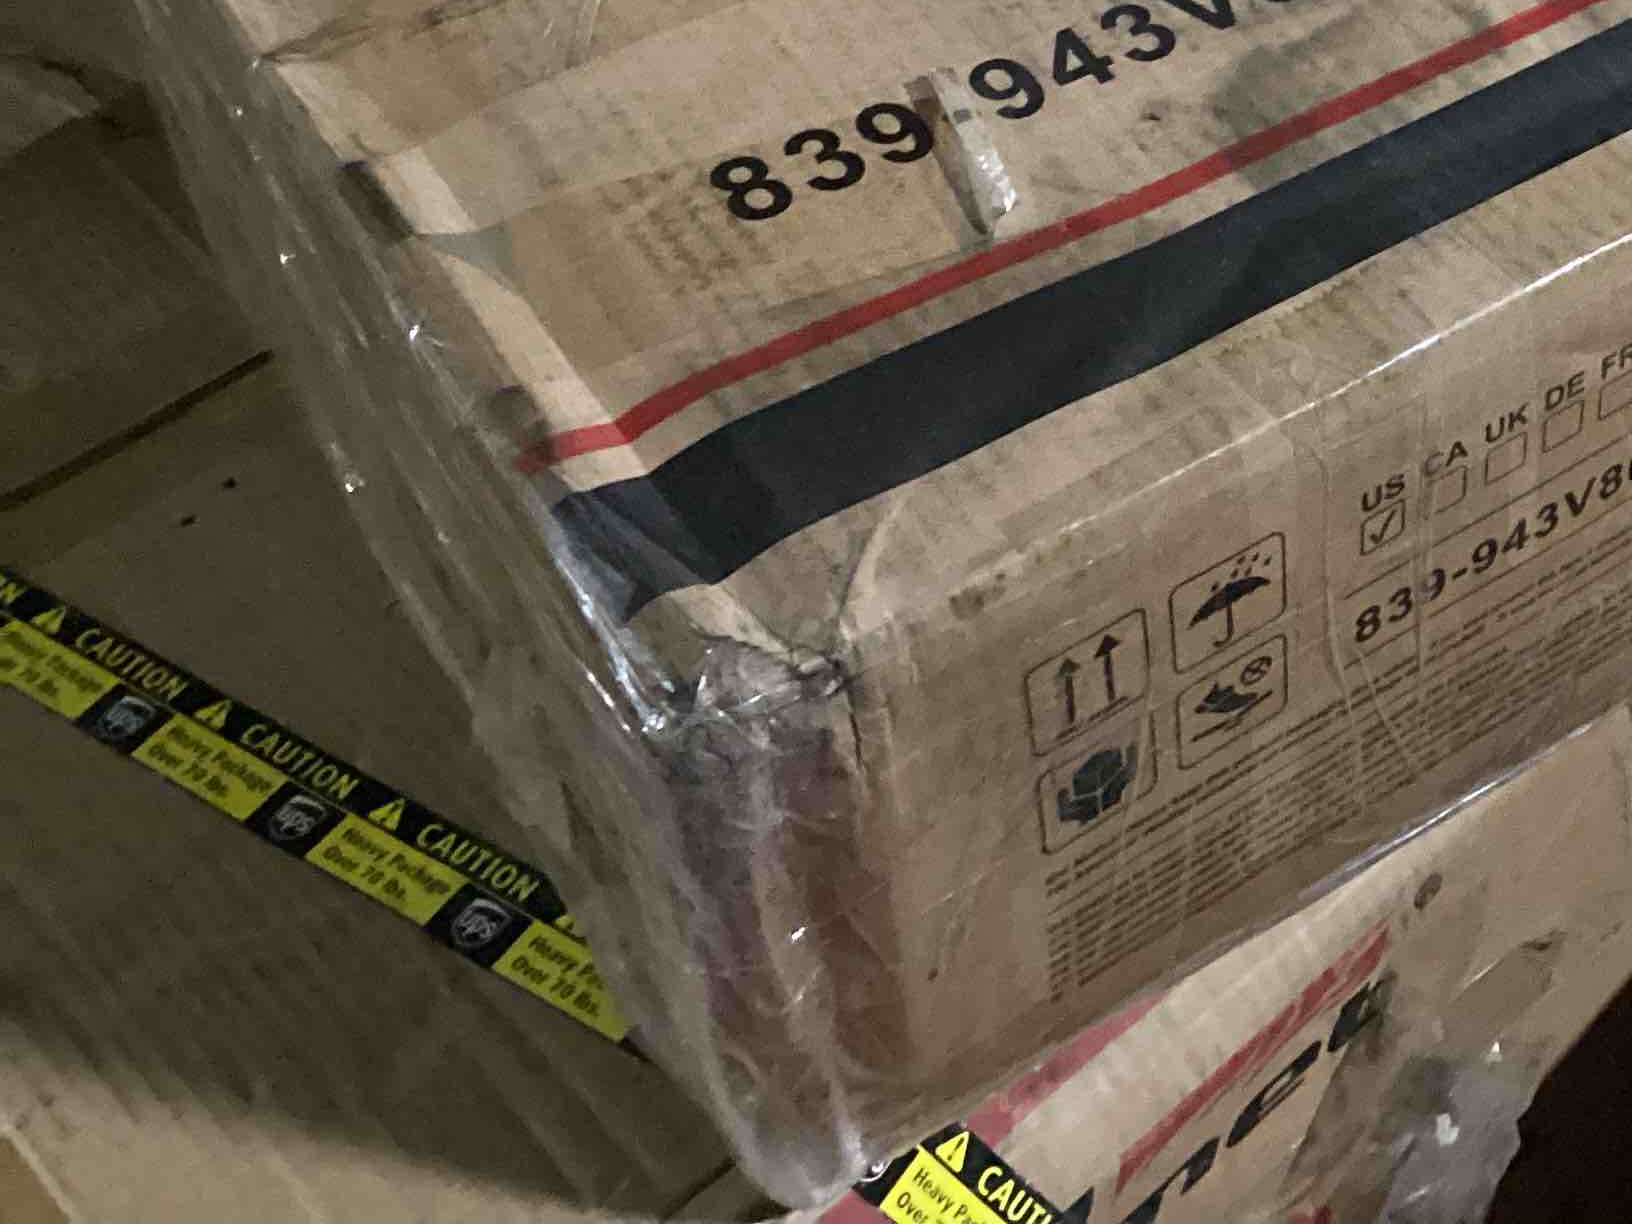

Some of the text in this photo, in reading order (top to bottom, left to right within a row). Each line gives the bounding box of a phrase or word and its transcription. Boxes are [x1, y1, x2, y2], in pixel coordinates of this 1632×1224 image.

[1361, 473, 1407, 513] US
[1424, 439, 1468, 479] CA
[1485, 403, 1529, 446] UK
[1544, 370, 1586, 412] DE
[75, 627, 191, 703] CAUTION
[240, 724, 360, 802] CAUTION
[415, 824, 542, 904] CAUTION
[911, 1166, 955, 1214] Heavy
